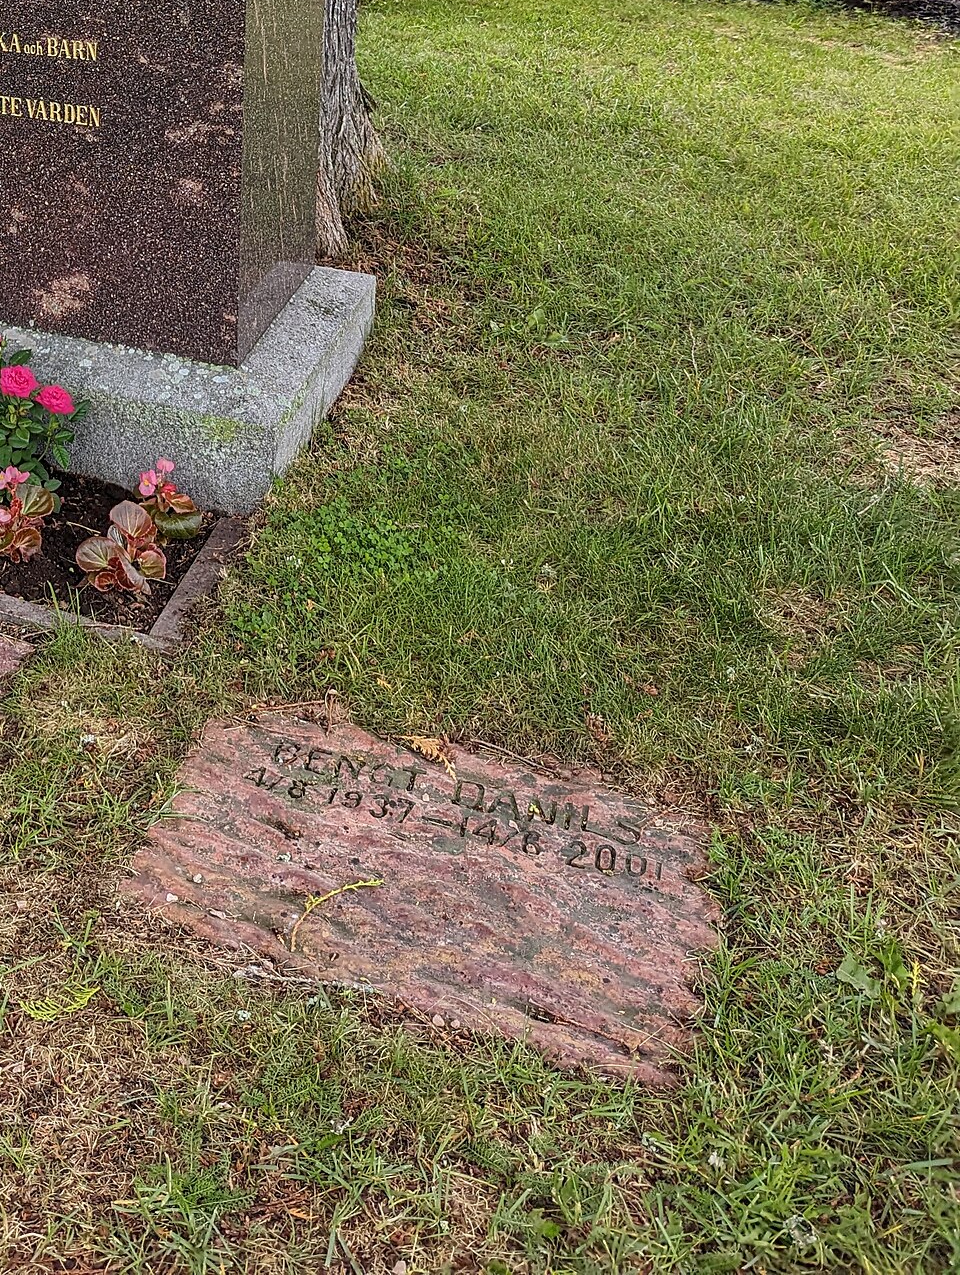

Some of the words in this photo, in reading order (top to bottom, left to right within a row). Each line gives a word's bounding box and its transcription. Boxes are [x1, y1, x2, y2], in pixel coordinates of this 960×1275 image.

[23, 41, 44, 56] och
[46, 37, 98, 62] BARN
[271, 741, 427, 792] BENGT
[327, 787, 417, 824] 1937
[564, 840, 663, 881] 2001
